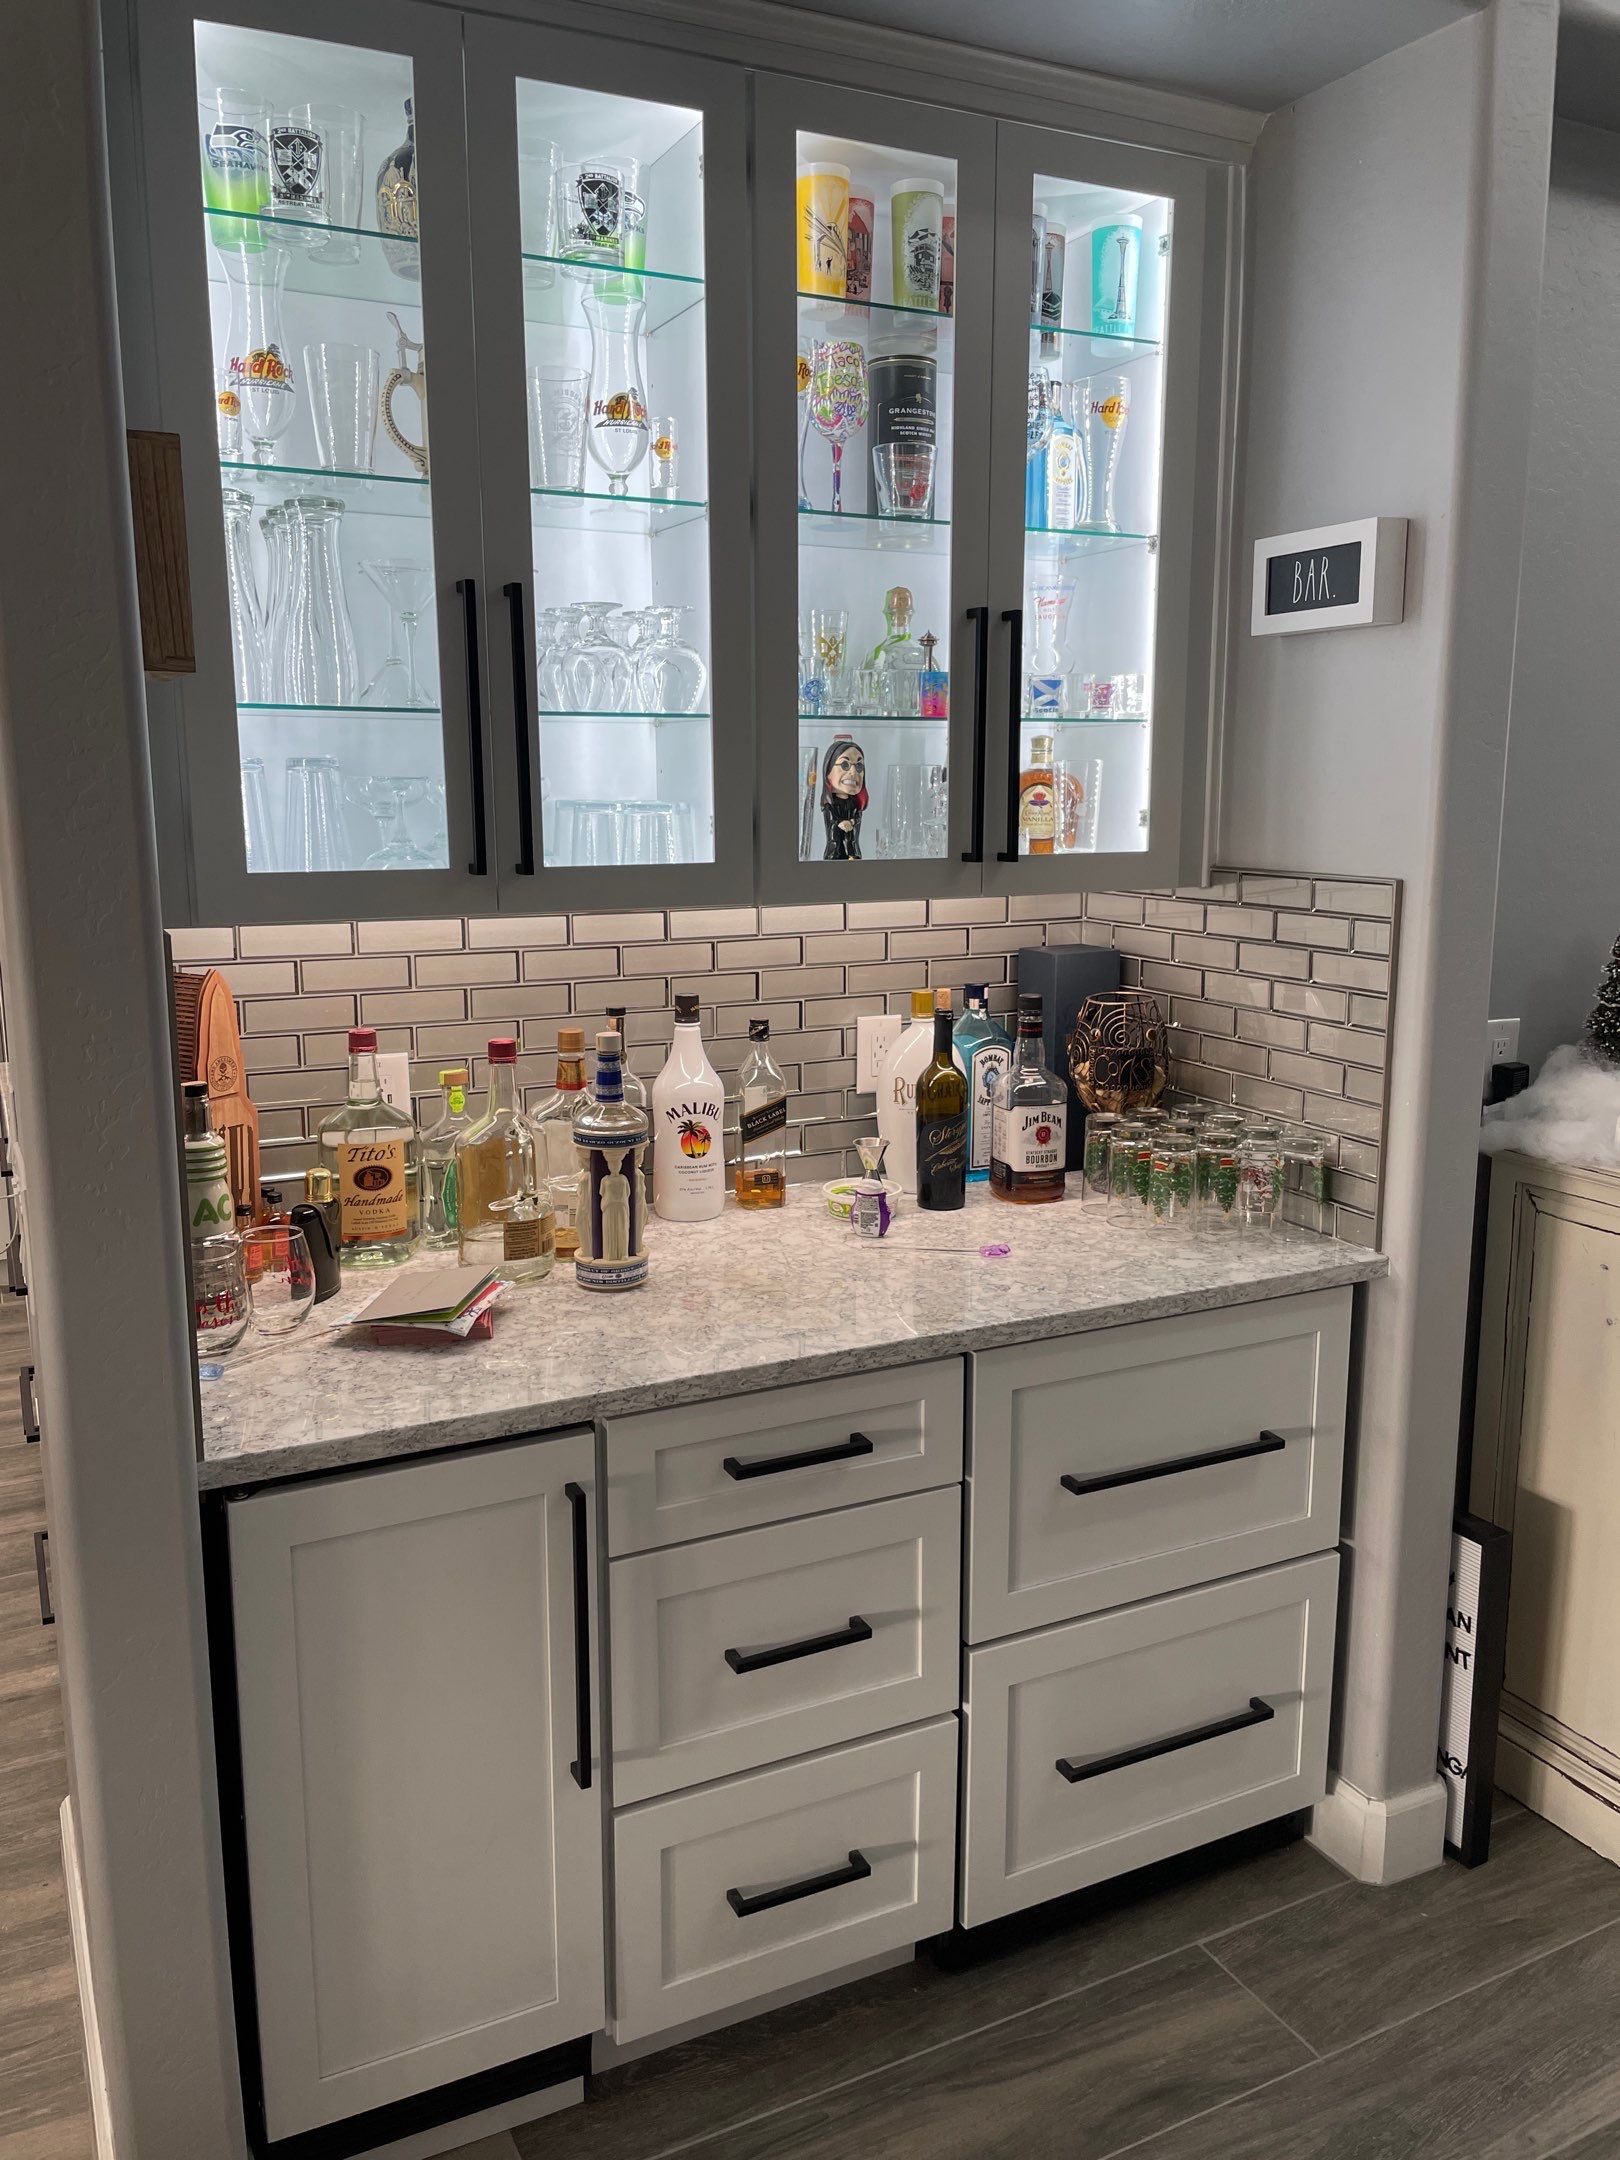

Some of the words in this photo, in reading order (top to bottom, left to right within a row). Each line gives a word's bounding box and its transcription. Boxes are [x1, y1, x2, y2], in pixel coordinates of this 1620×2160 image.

[825, 352, 860, 369] Taco
[1091, 401, 1116, 414] Hard
[980, 1054, 1004, 1068] BOMBAY
[1094, 1053, 1152, 1090] Corks
[665, 1102, 721, 1124] MALIBU
[747, 1116, 768, 1129] BLACK
[768, 1107, 786, 1119] LABEL
[1022, 1115, 1040, 1131] JIM
[1041, 1111, 1063, 1129] BEAM
[347, 1144, 396, 1162] Tito's
[1025, 1153, 1058, 1165] BOURBON
[343, 1189, 404, 1208] Handmade
[359, 1207, 391, 1216] VODKA
